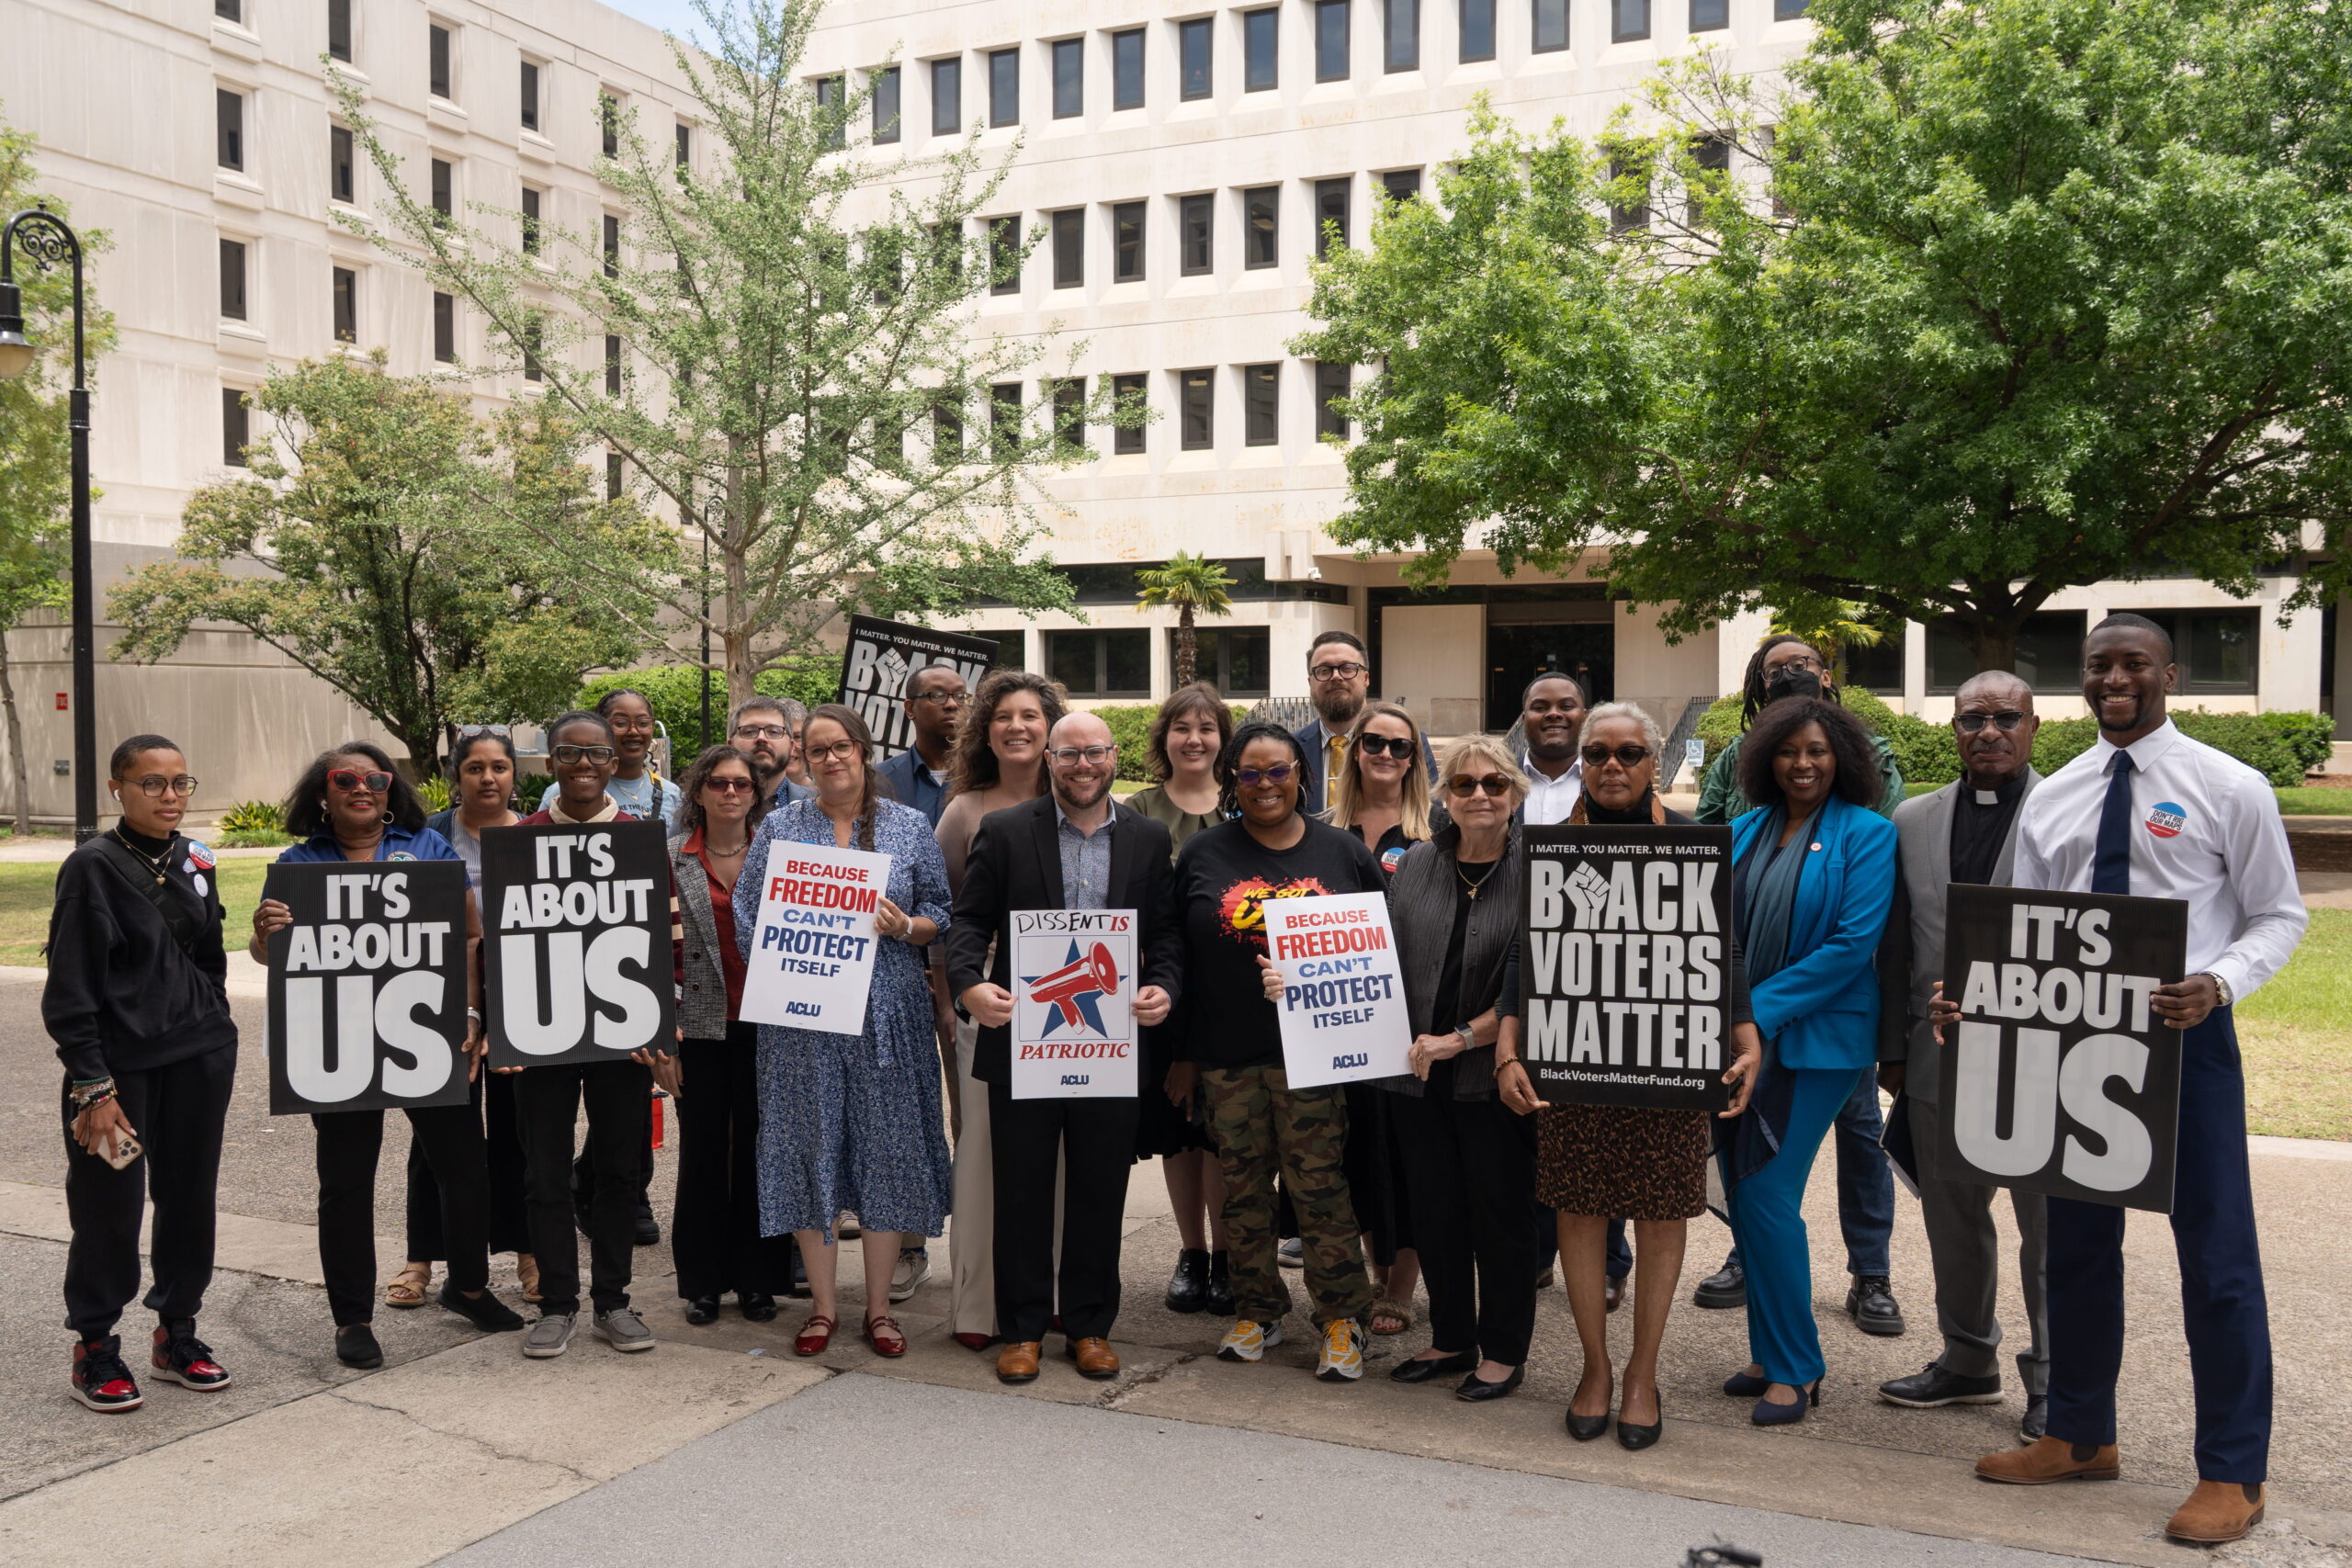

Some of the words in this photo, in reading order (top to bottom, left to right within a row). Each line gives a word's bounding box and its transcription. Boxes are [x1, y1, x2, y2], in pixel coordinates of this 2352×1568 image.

[860, 629, 891, 642] MATTER.
[893, 636, 910, 645] YOU
[910, 638, 942, 651] MATTER.
[944, 646, 956, 655] WE
[957, 649, 989, 661] MATTER.
[2150, 815, 2164, 824] OUR
[2164, 819, 2182, 831] MAPS
[2153, 809, 2174, 820] DON'T
[2173, 815, 2185, 825] RIG
[536, 832, 615, 879] IT'S
[1536, 844, 1578, 853] MATTER.
[1582, 845, 1605, 853] YOU
[1608, 845, 1652, 854] MATTER.
[1655, 846, 1672, 854] WE
[1675, 846, 1721, 855] MATTER.
[786, 860, 868, 883] BECAUSE
[326, 872, 411, 919] IT'S
[500, 879, 654, 929] ABOUT
[769, 876, 877, 914] FREEDOM
[1242, 887, 1273, 899] WE
[1275, 888, 1312, 898] GOT
[783, 908, 856, 930] CAN'T
[1015, 912, 1111, 933] DISSENT
[1109, 916, 1129, 931] IS
[1232, 899, 1266, 931] U
[1285, 909, 1370, 929] BECAUSE
[286, 921, 451, 972] ABOUT
[762, 925, 869, 962] PROTECT
[1276, 926, 1387, 961] FREEDOM
[2010, 904, 2111, 966] IT'S
[781, 957, 841, 977] ITSELF
[1298, 956, 1373, 978] CAN'T
[1530, 931, 1721, 1001] VOTERS
[500, 925, 661, 1055] US
[1285, 974, 1393, 1011] PROTECT
[1961, 961, 2160, 1032] ABOUT
[786, 1001, 820, 1017] ACLU
[1313, 1008, 1374, 1029] ITSELF
[286, 970, 453, 1103] US
[1527, 998, 1721, 1070] MATTER
[1019, 1043, 1130, 1060] PATRIOTIC
[1332, 1053, 1368, 1070] ACLU
[1060, 1075, 1089, 1085] ACLU
[1540, 1068, 1705, 1089] BlackVotersMatterFund.org
[1954, 1021, 2153, 1191] US
